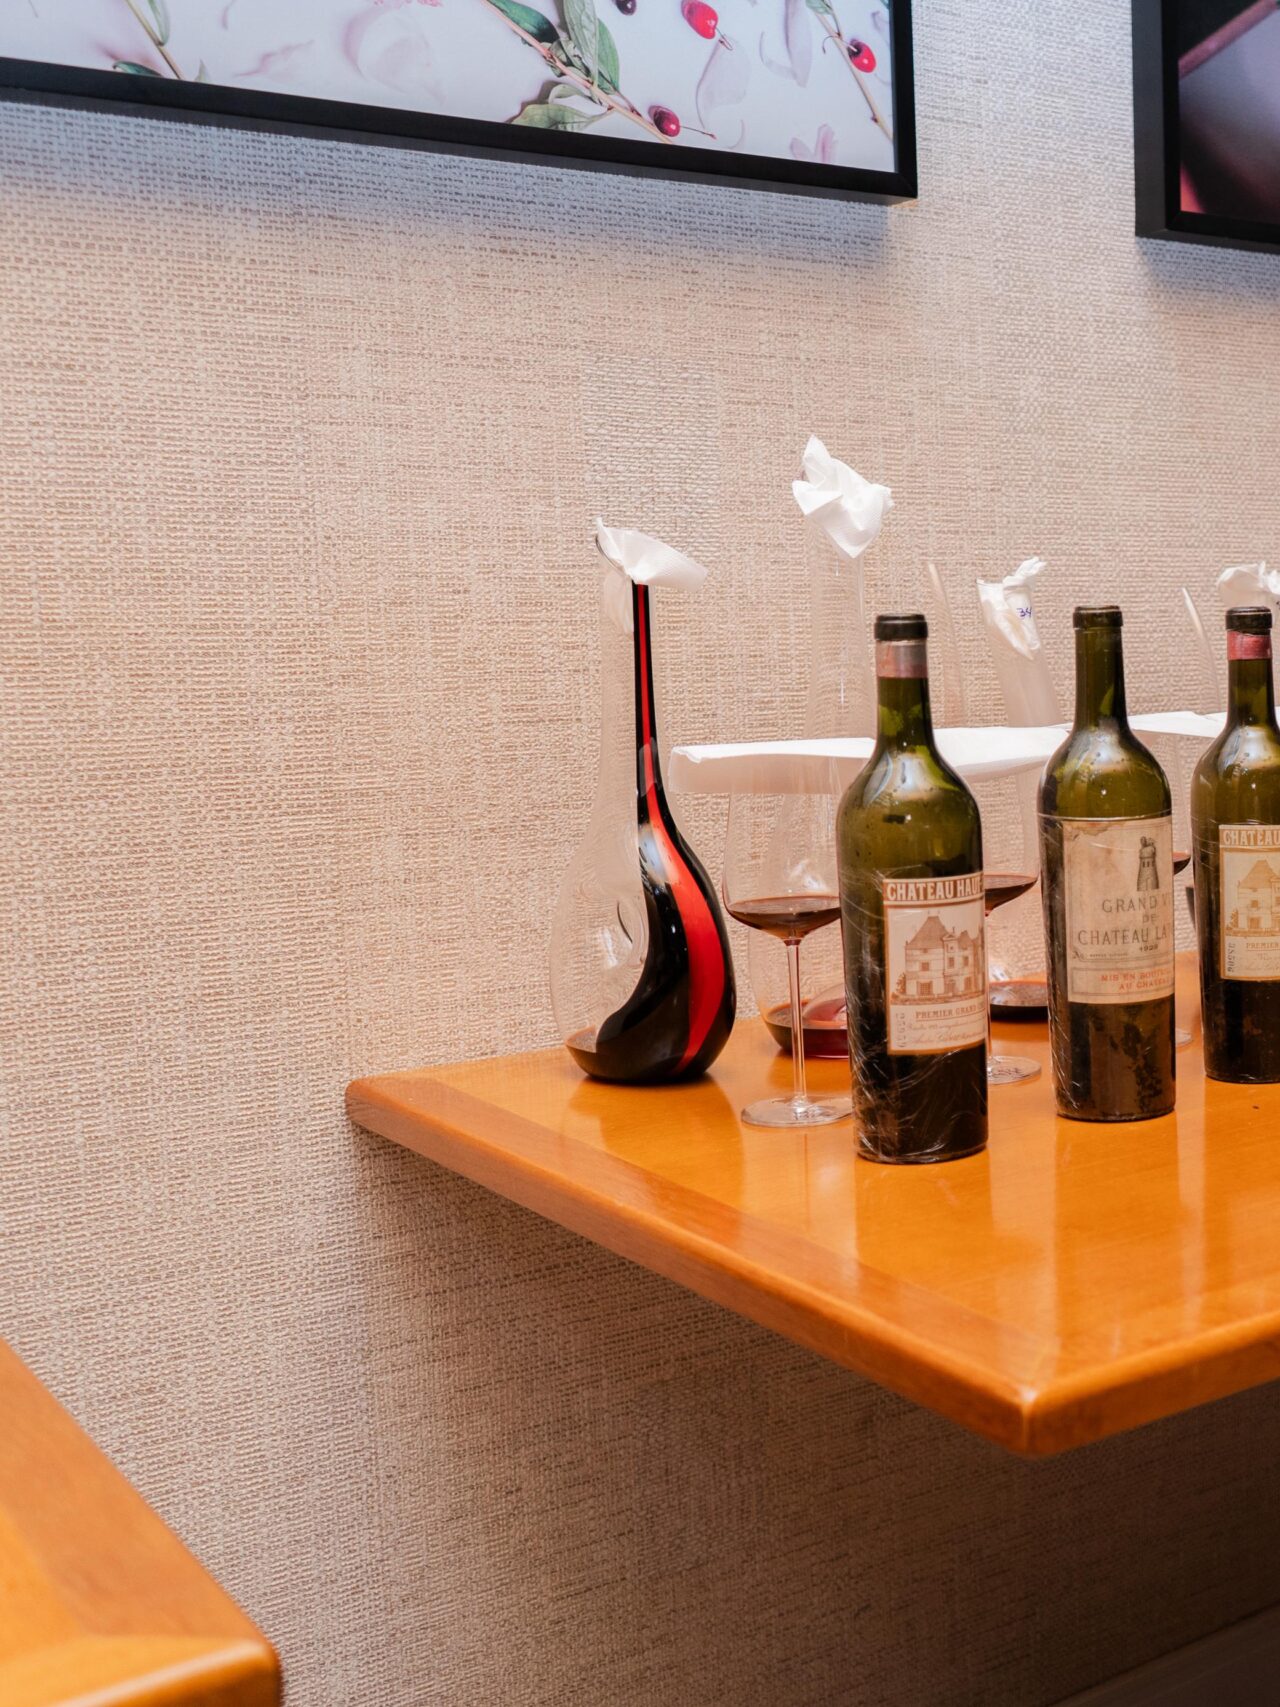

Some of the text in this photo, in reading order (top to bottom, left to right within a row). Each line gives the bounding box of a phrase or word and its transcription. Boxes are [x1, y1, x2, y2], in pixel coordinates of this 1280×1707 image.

[1223, 830, 1280, 846] CHATEAU
[886, 880, 954, 901] CHATEAU
[1102, 895, 1158, 913] GRAND
[1142, 913, 1156, 924] DE
[1078, 927, 1149, 946] CHATEAU
[1246, 942, 1279, 950] PREMIER
[915, 1009, 953, 1020] PREMIER
